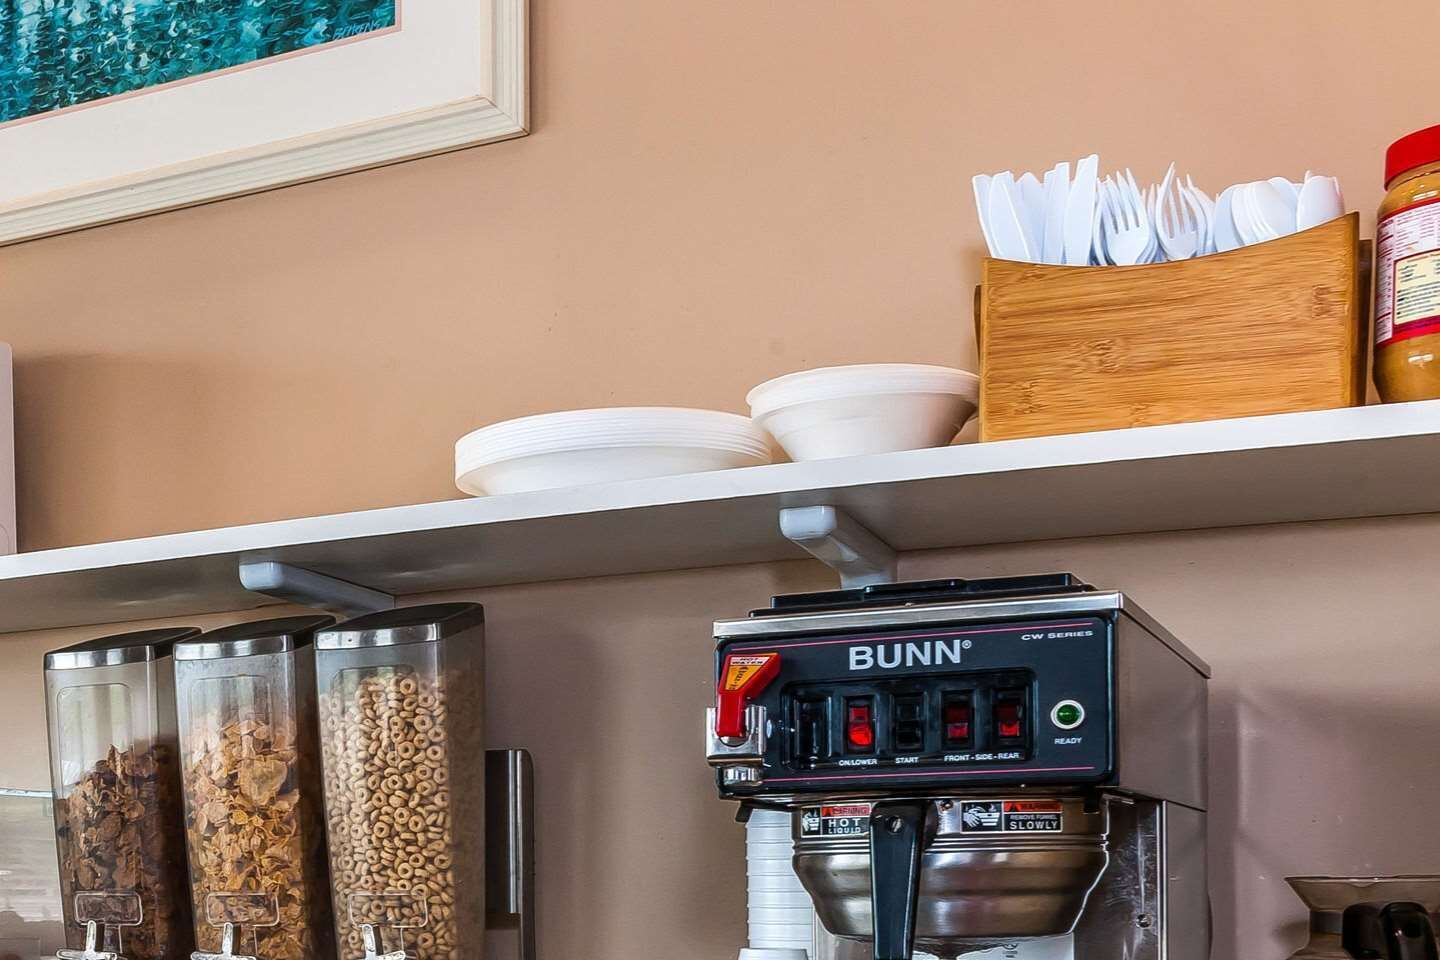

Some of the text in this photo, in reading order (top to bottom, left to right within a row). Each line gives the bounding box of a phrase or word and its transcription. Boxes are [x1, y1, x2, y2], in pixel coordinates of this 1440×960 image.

[1047, 630, 1094, 639] SERIES
[1054, 737, 1082, 745] READY
[895, 756, 919, 764] START
[975, 753, 993, 761] SIDE
[998, 752, 1019, 760] REAR
[828, 818, 861, 828] HOT
[1010, 821, 1058, 830] SLOWLY
